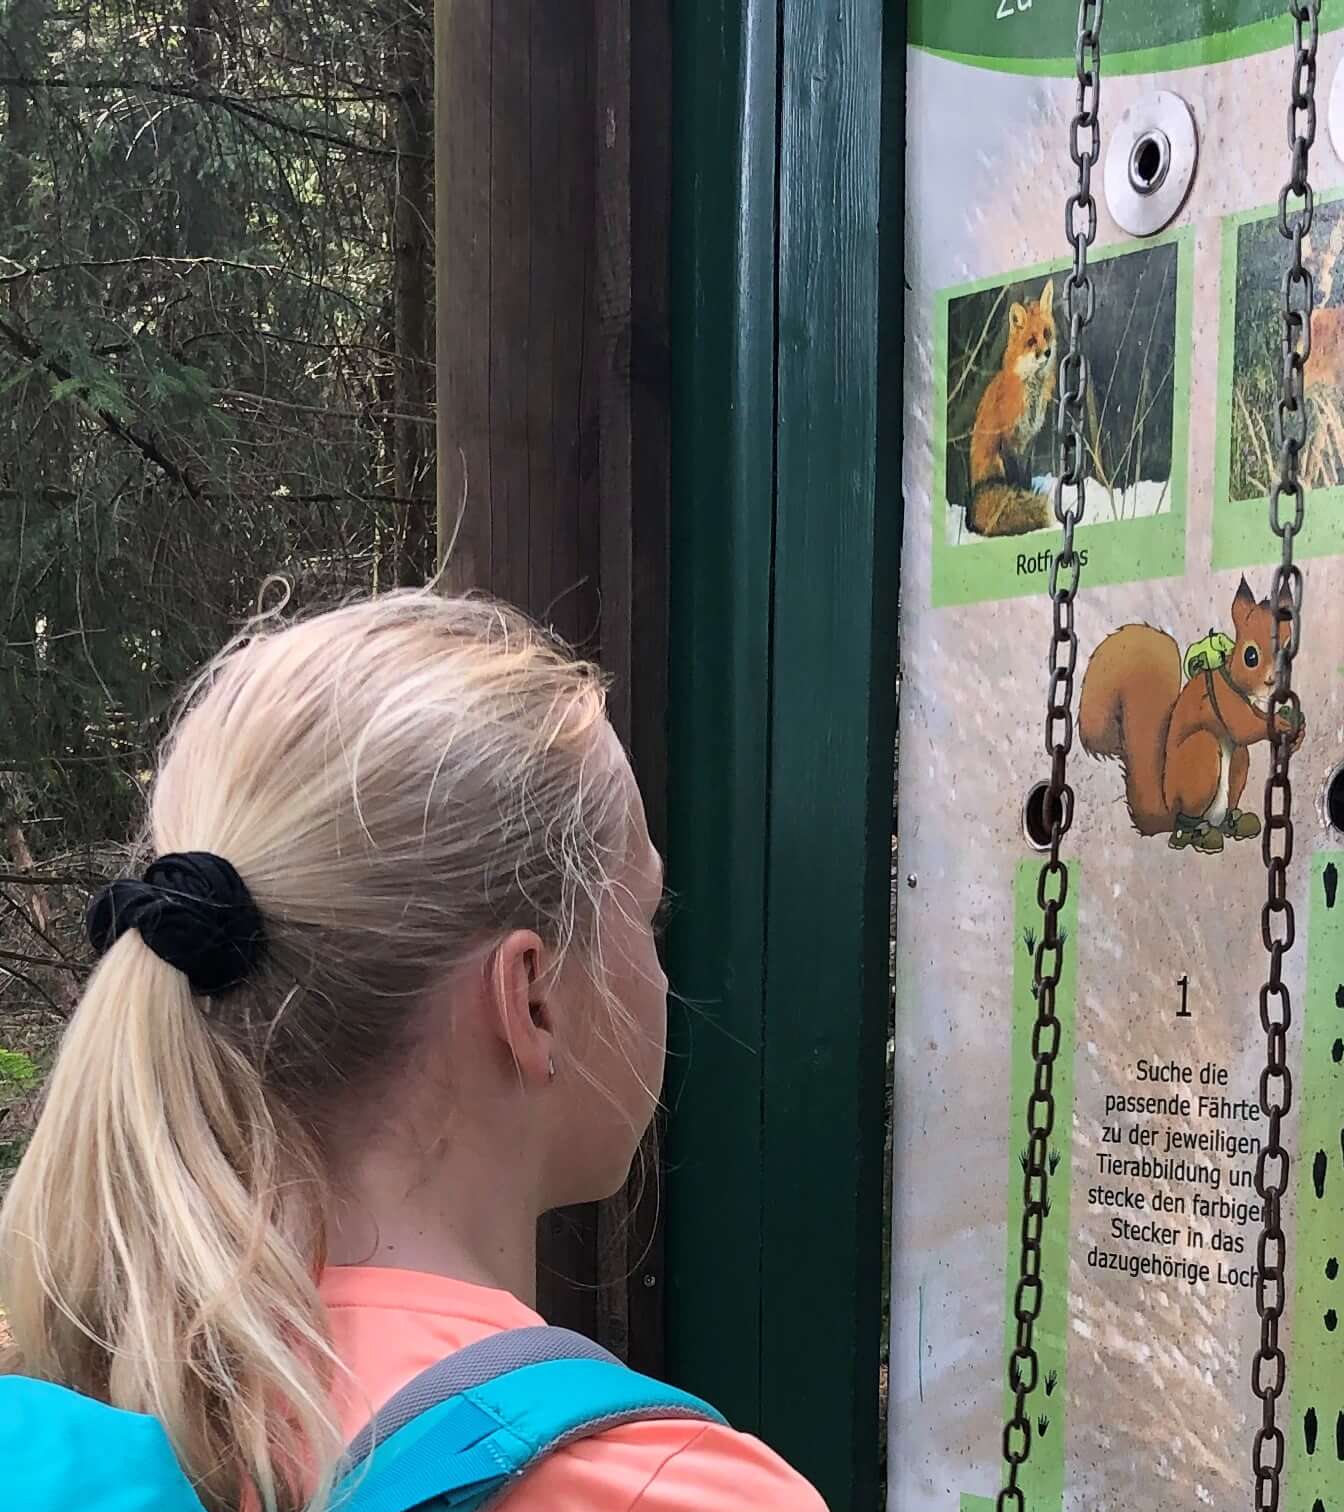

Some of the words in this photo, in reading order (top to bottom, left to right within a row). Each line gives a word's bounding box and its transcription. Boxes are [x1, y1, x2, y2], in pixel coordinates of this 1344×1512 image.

[1017, 549, 1088, 576] Rotfs
[1176, 975, 1192, 1017] 1
[1136, 1060, 1193, 1085] Suche
[1199, 1062, 1229, 1086] die
[1105, 1093, 1191, 1117] passende
[1198, 1096, 1261, 1122] Fährte
[1102, 1125, 1121, 1145] zu
[1128, 1126, 1159, 1148] der
[1163, 1128, 1262, 1159] jeweiligen
[1096, 1152, 1221, 1190] Tierabbildung
[1229, 1168, 1256, 1189] un
[1087, 1186, 1145, 1210] stecke
[1152, 1190, 1185, 1214] den
[1111, 1217, 1181, 1247] Stecker
[1187, 1228, 1204, 1249] in
[1211, 1228, 1245, 1254] das
[1087, 1246, 1210, 1286] dazugehörige
